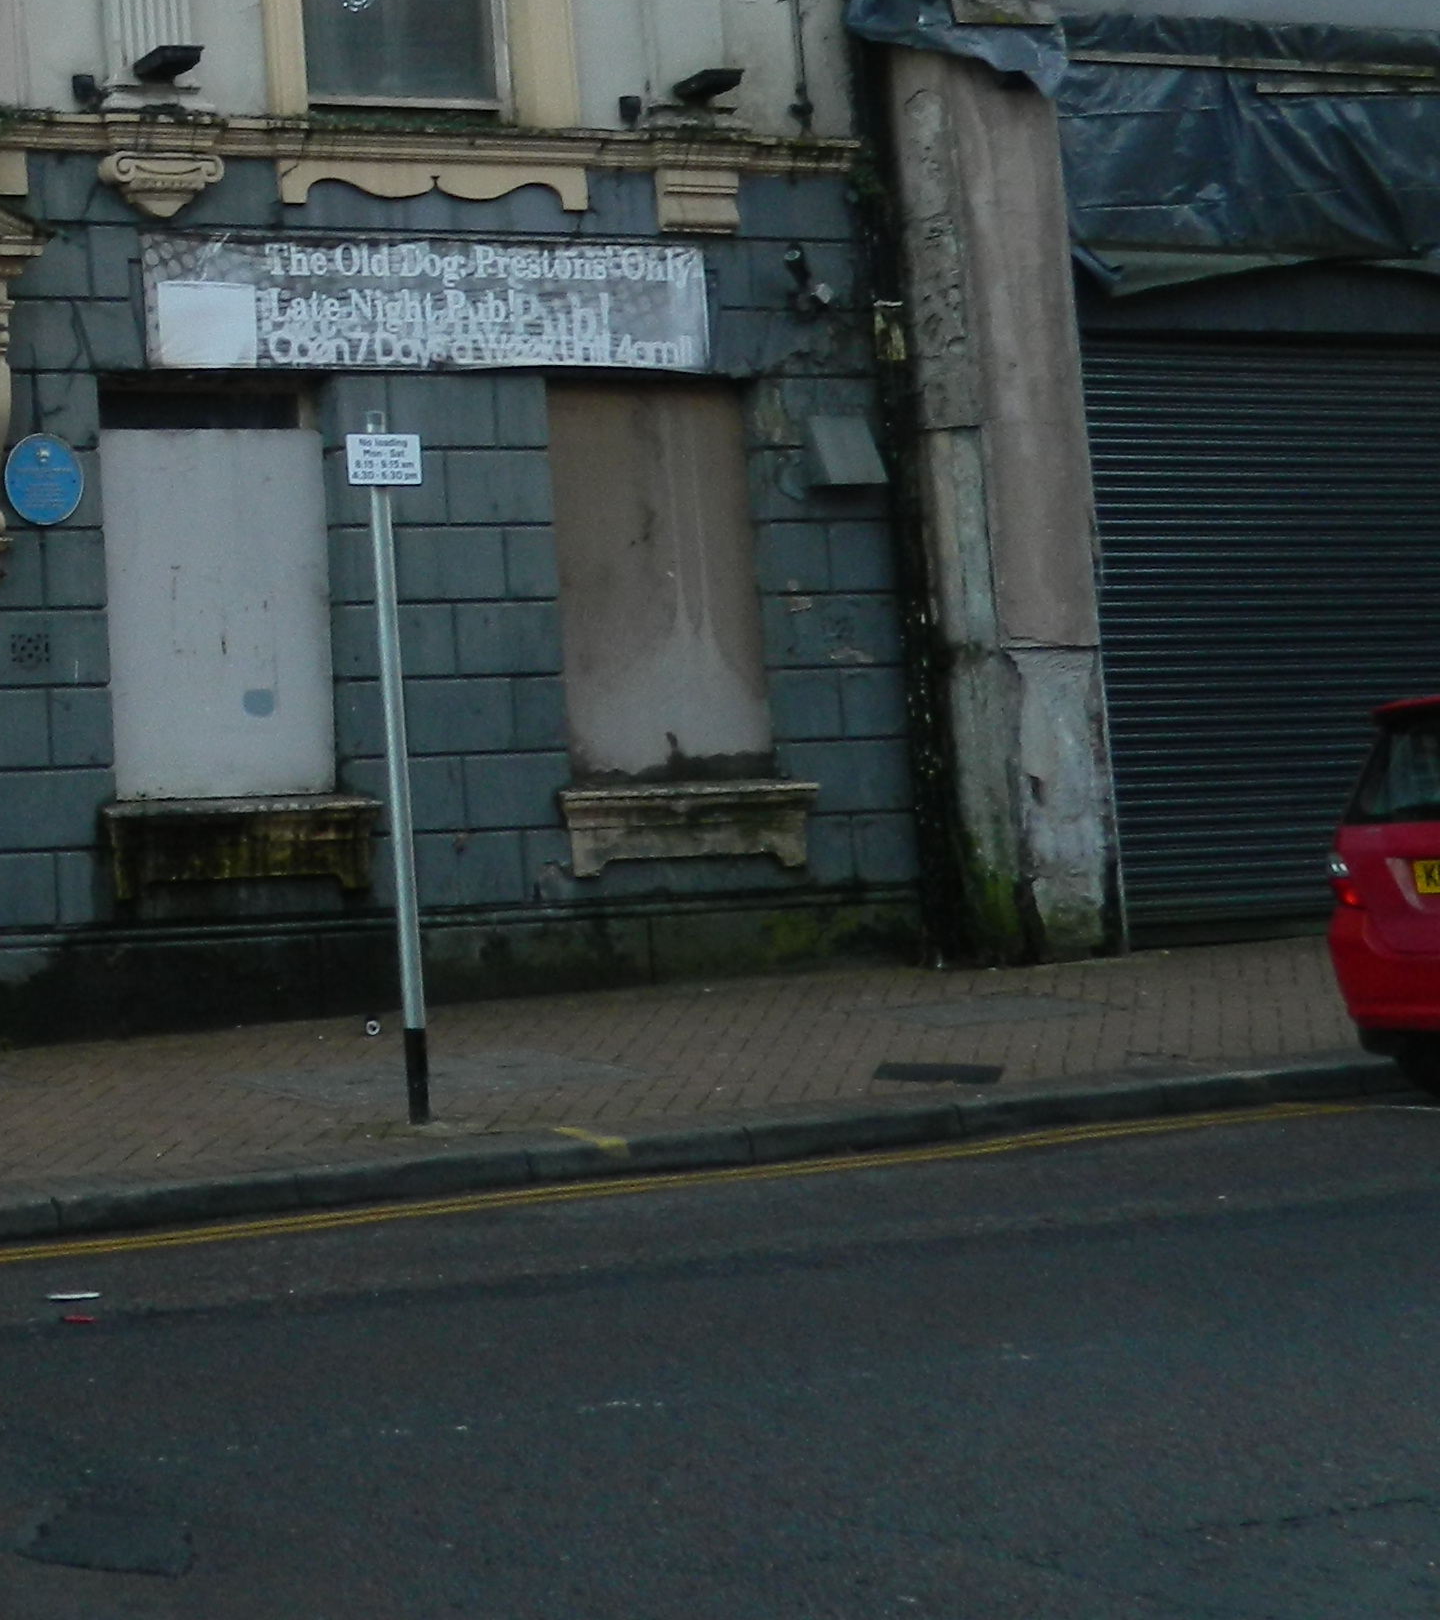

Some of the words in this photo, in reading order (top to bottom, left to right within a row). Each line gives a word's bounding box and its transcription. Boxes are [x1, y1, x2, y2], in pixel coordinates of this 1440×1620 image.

[264, 243, 328, 277] The
[334, 244, 391, 277] Old
[618, 248, 691, 287] Only
[267, 289, 346, 324] Late
[349, 289, 438, 329] Night
[443, 290, 518, 323] Pub!
